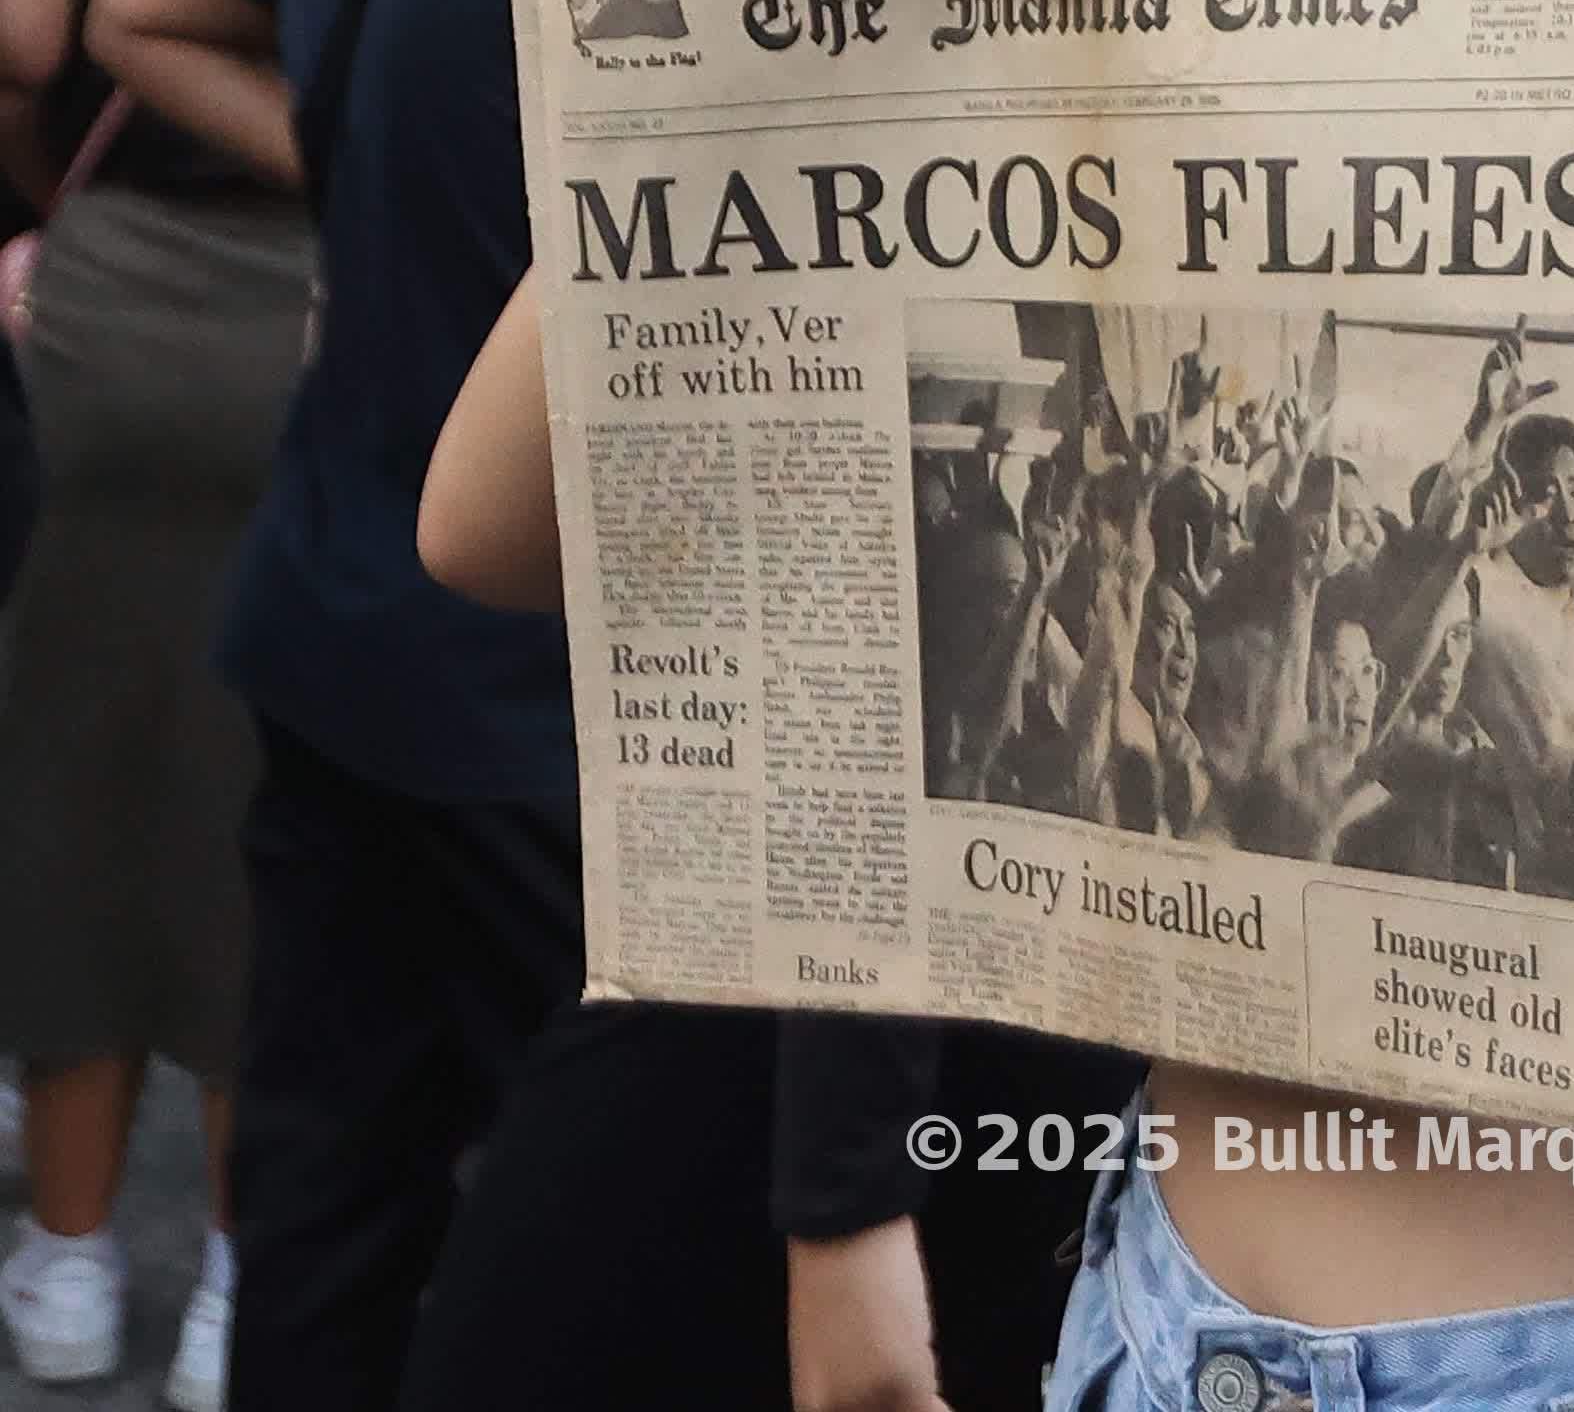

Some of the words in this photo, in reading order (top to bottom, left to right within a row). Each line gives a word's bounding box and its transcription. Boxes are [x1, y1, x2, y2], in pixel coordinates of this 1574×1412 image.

[564, 153, 1122, 282] MARCOS
[605, 307, 765, 353] Family,
[769, 305, 843, 343] Ver
[608, 361, 665, 399] off
[682, 357, 772, 396] with
[789, 356, 865, 393] him
[609, 643, 739, 678] Revolt's
[612, 689, 672, 723] last
[681, 690, 748, 729] day:
[617, 733, 650, 765] 13
[661, 735, 735, 769] dead
[963, 837, 1065, 916] Cory
[1080, 860, 1267, 951] installed
[796, 954, 880, 986] Banks
[1371, 916, 1540, 980] Inaugural
[1373, 967, 1497, 1023] showed
[1510, 994, 1562, 1036] old
[1373, 1017, 1471, 1068] elite's
[1485, 1038, 1572, 1091] faces
